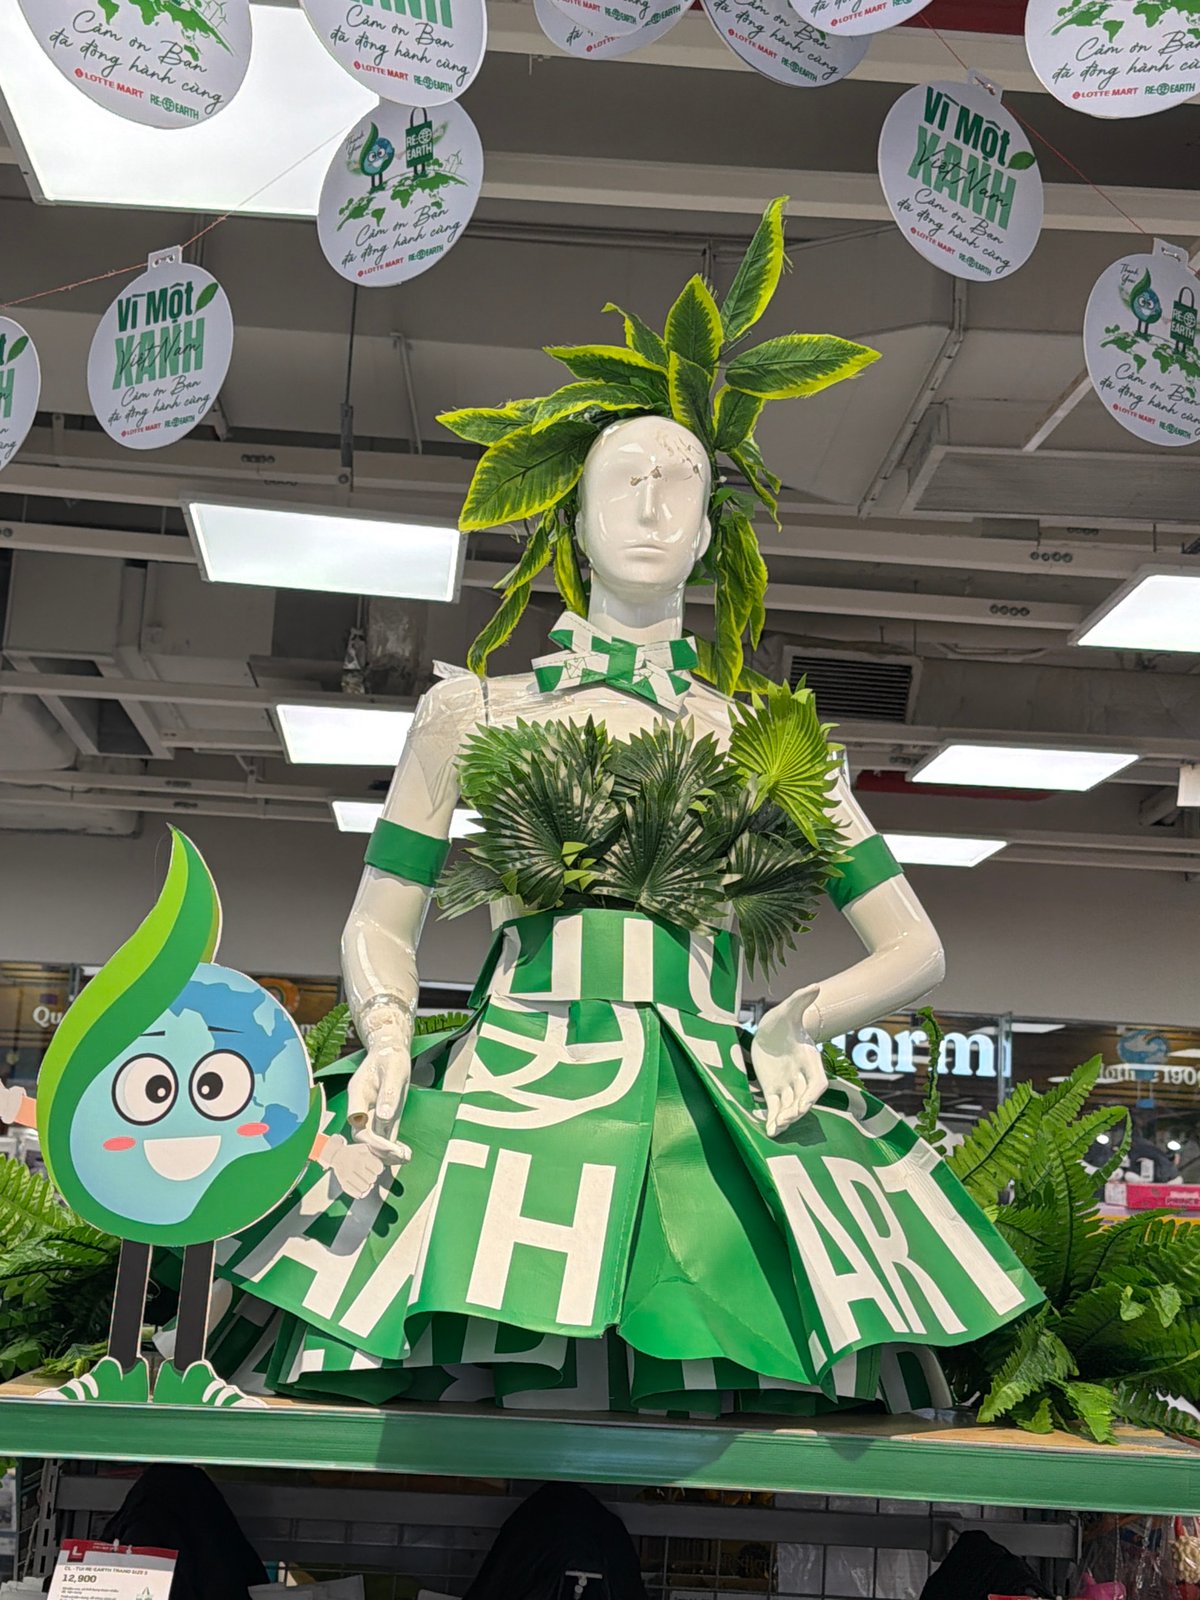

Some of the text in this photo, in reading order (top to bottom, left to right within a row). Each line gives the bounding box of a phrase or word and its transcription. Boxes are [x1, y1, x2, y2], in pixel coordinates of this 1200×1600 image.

[583, 1, 600, 12] MART
[839, 11, 863, 24] LOTTE
[864, 3, 887, 16] MART
[415, 22, 454, 49] Bạn
[734, 32, 756, 48] LOTTE
[757, 44, 778, 59] MART
[158, 40, 207, 73] Bạn
[394, 41, 432, 64] hành
[436, 58, 471, 87] cùng
[770, 29, 804, 54] hành
[807, 50, 840, 80] cùng
[1126, 55, 1174, 75] hành
[49, 28, 73, 49] đã
[129, 56, 177, 85] hành
[181, 81, 225, 116] cùng
[85, 72, 115, 88] LOTTE
[116, 83, 144, 99] MART
[362, 64, 386, 75] LOTTE
[387, 69, 409, 81] MART
[1081, 90, 1110, 98] LOTTE
[1111, 87, 1139, 96] MART
[406, 142, 432, 160] EARTH
[907, 125, 1016, 231] XANH
[951, 169, 1008, 207] Nam
[937, 241, 955, 255] MART
[364, 265, 384, 275] LOTTE
[385, 257, 404, 268] MART
[146, 281, 193, 325] Một
[1171, 321, 1194, 339] EARTH
[112, 317, 205, 390] XANH
[150, 328, 201, 367] Nam
[62, 1574, 97, 1583] 12,900
